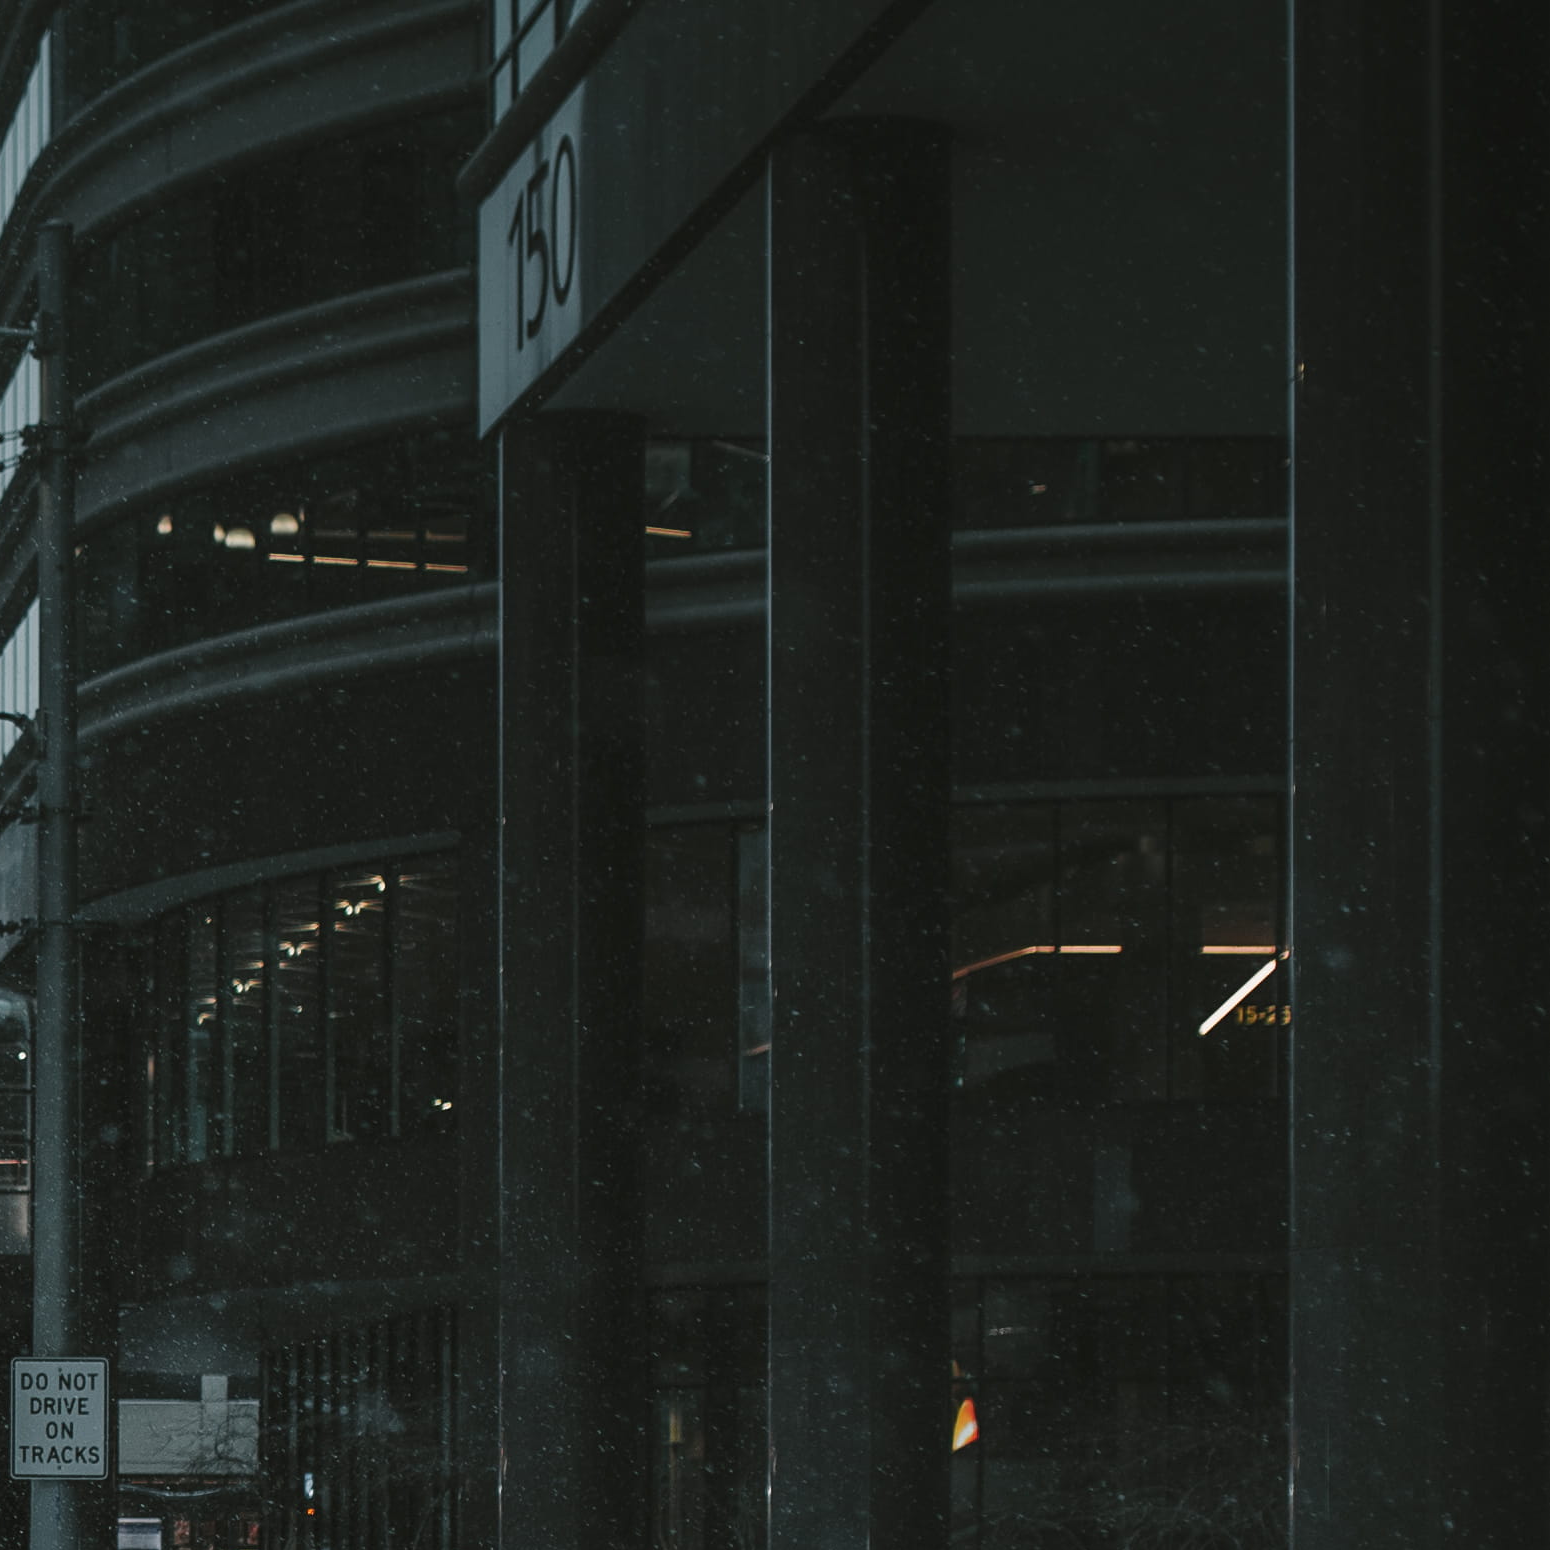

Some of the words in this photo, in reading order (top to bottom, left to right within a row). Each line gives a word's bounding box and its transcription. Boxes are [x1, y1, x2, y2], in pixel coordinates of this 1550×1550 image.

[507, 133, 577, 353] 150
[21, 1372, 48, 1390] DO
[58, 1372, 98, 1391] NOT
[30, 1397, 89, 1415] DRIVE
[46, 1422, 74, 1439] ON
[19, 1445, 100, 1464] TRACKS
